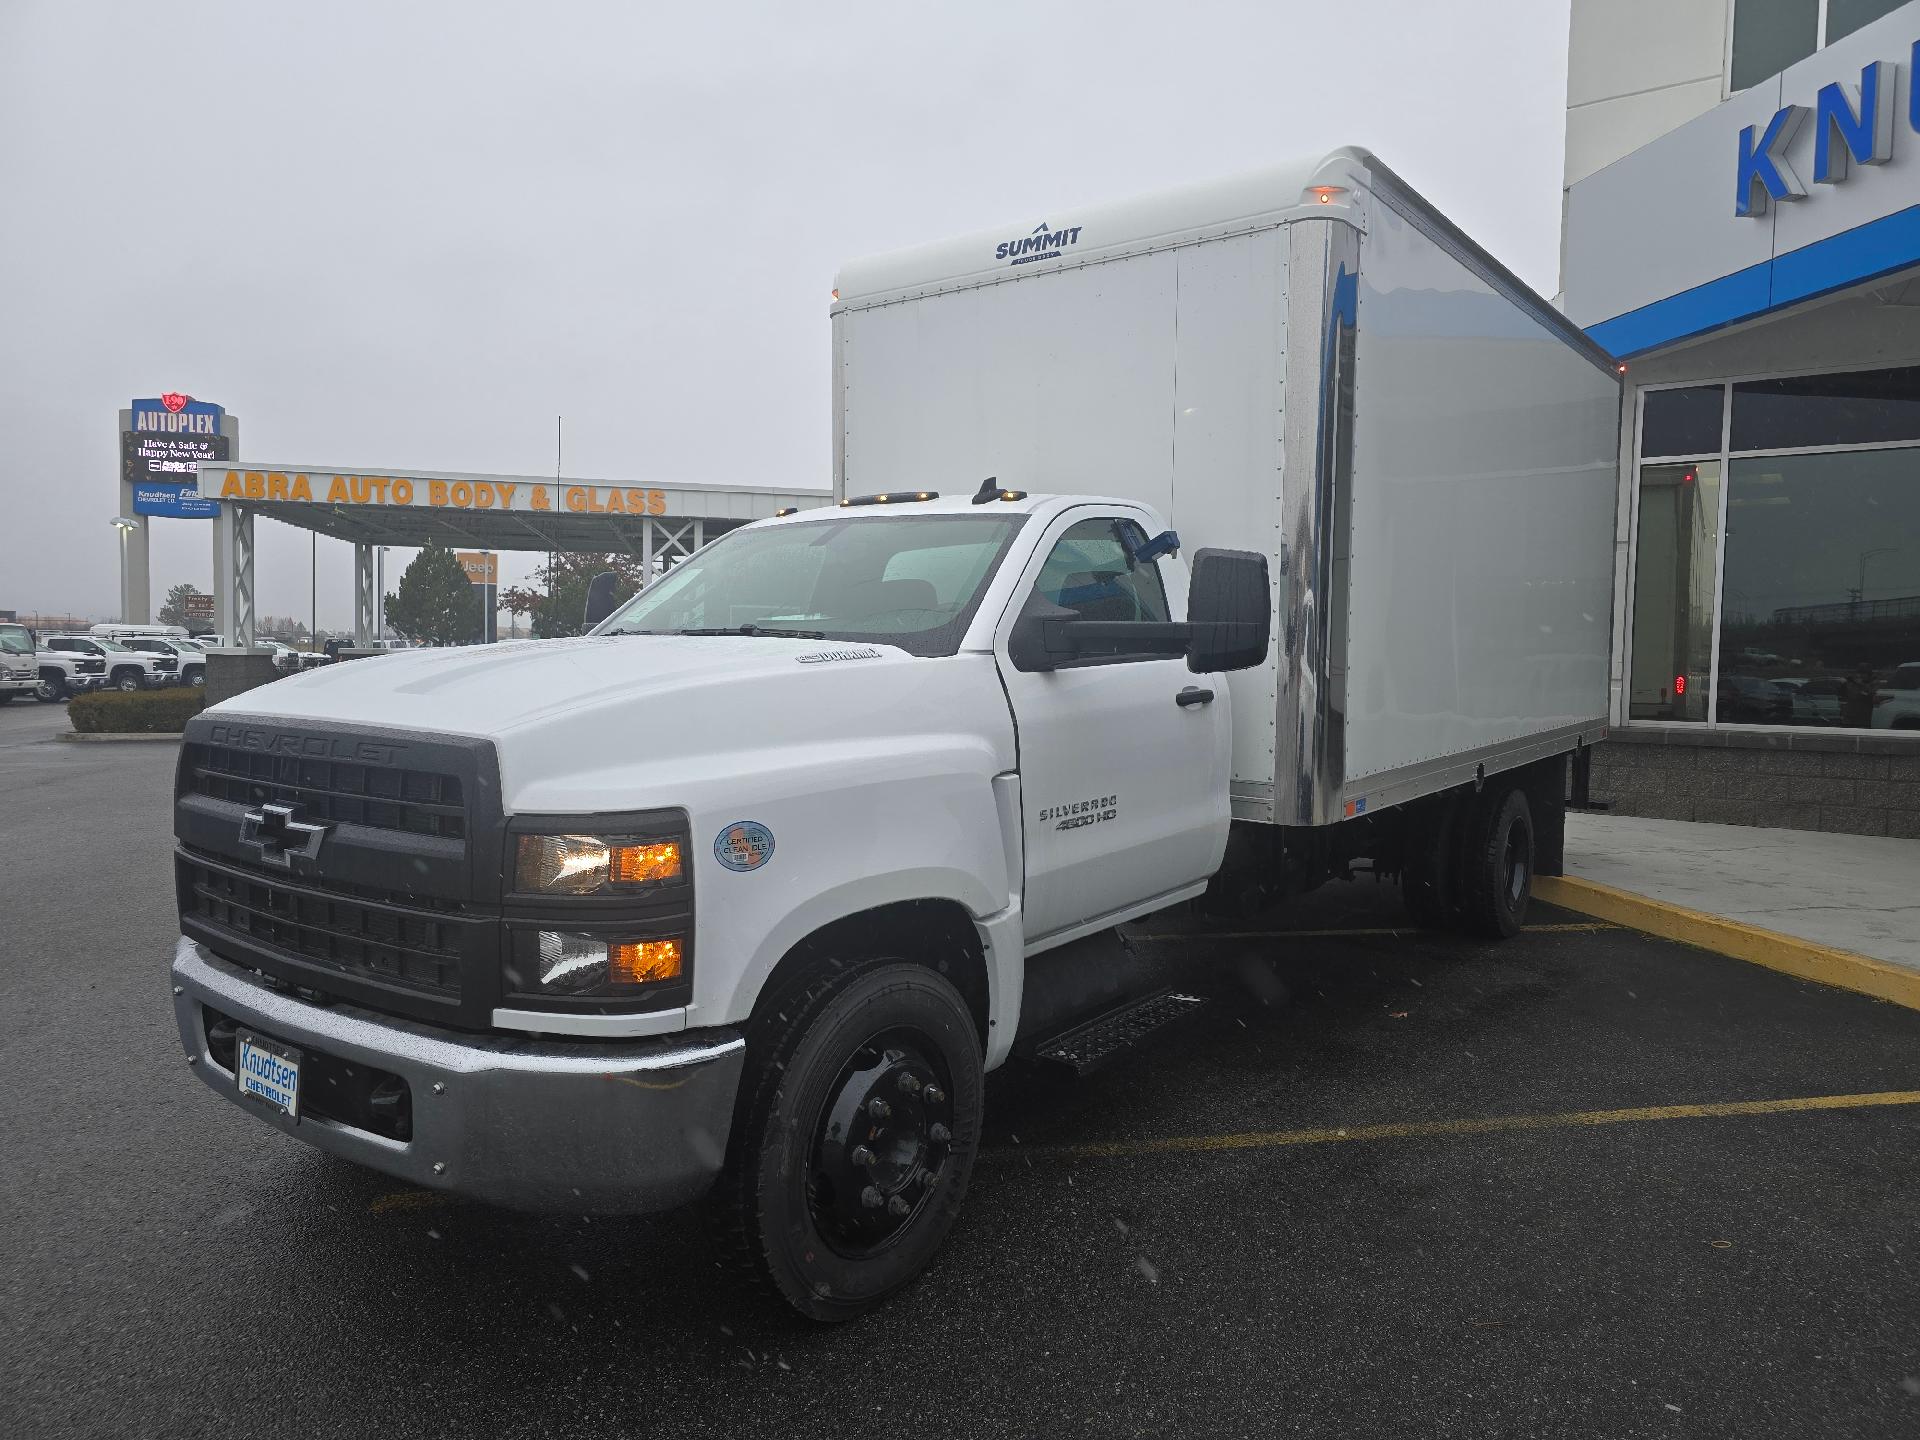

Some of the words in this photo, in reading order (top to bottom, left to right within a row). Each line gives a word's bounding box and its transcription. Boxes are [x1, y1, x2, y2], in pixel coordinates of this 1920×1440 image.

[1735, 40, 1920, 217] KN
[995, 226, 1082, 259] SUMMIT
[138, 411, 214, 433] AUTOPLEX
[138, 448, 168, 458] Happy
[144, 440, 167, 448] Have
[220, 471, 312, 500] ABRA
[327, 475, 413, 505] AUTO
[429, 479, 517, 509] BODY
[531, 484, 551, 511] &
[566, 486, 666, 516] GLASS
[464, 560, 493, 575] Jeep
[211, 726, 408, 765] CHEVROLET
[1040, 794, 1116, 821] SILVERADO
[1097, 809, 1116, 822] HD
[242, 1043, 296, 1091] Knudtsen
[246, 1077, 291, 1107] CHEVROLET
